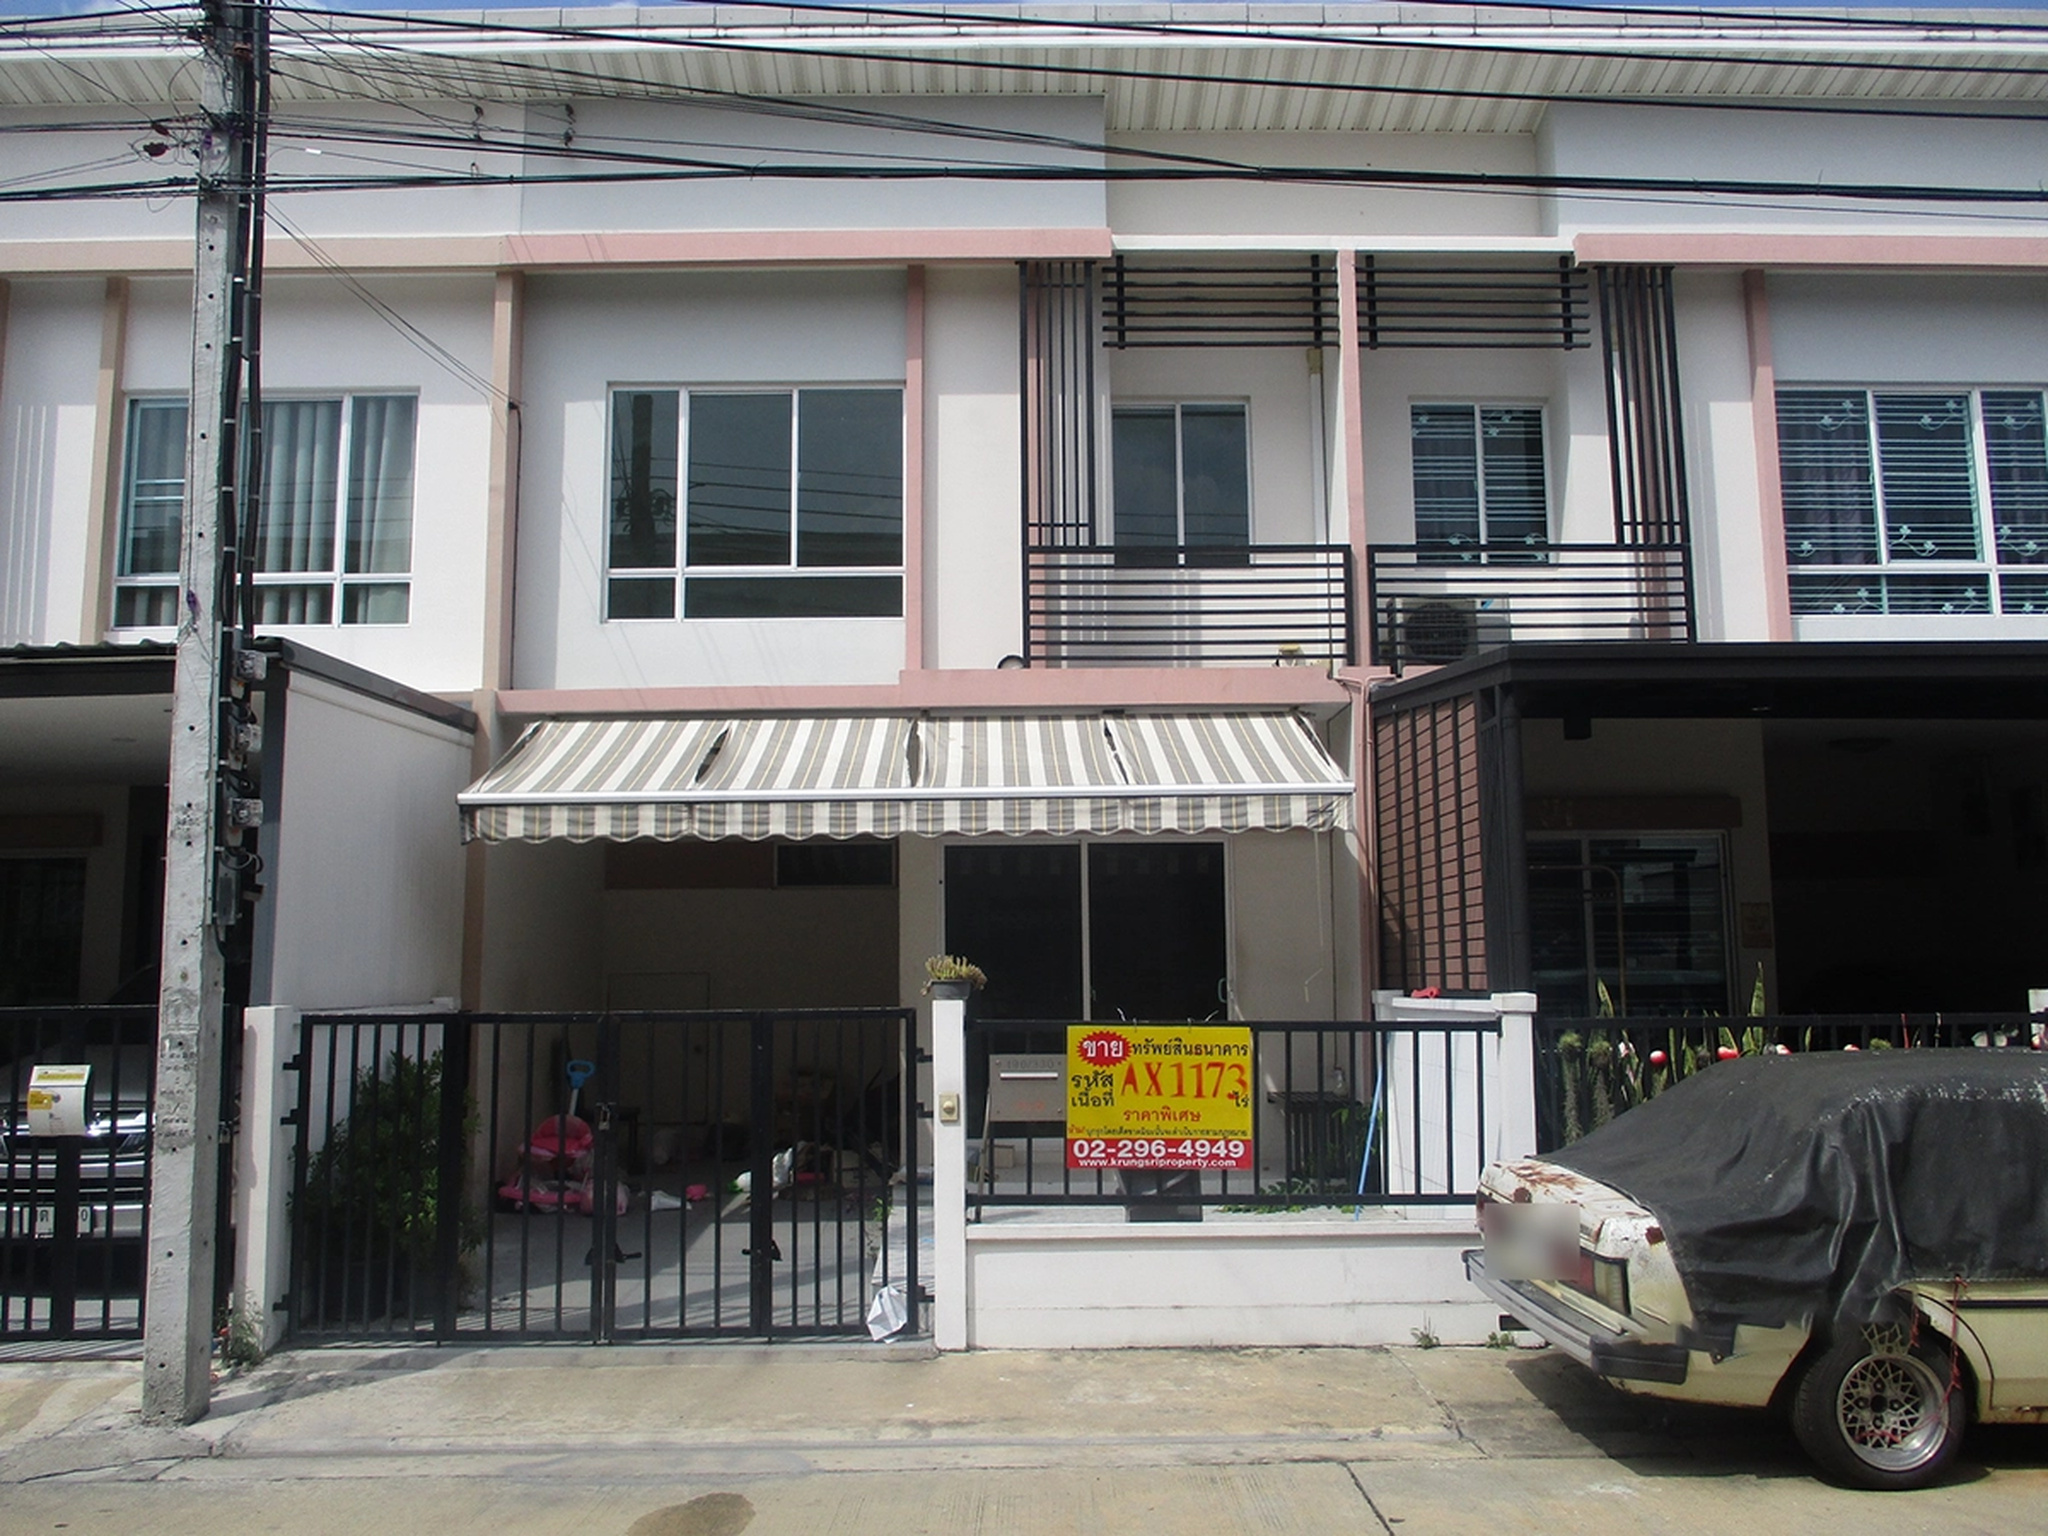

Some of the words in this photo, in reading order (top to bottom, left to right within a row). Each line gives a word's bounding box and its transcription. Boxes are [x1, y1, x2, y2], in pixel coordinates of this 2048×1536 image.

[1082, 1040, 1123, 1057] ขาย
[1132, 1037, 1249, 1056] ทรัพย์สินธนาคาร
[1071, 1069, 1114, 1088] รหัส
[1121, 1062, 1248, 1100] AX1173
[1123, 1105, 1202, 1121] ราคาพิเศษ
[1073, 1139, 1245, 1158] 02-296-4949
[1078, 1157, 1237, 1168] www.krungsriproperty.com
